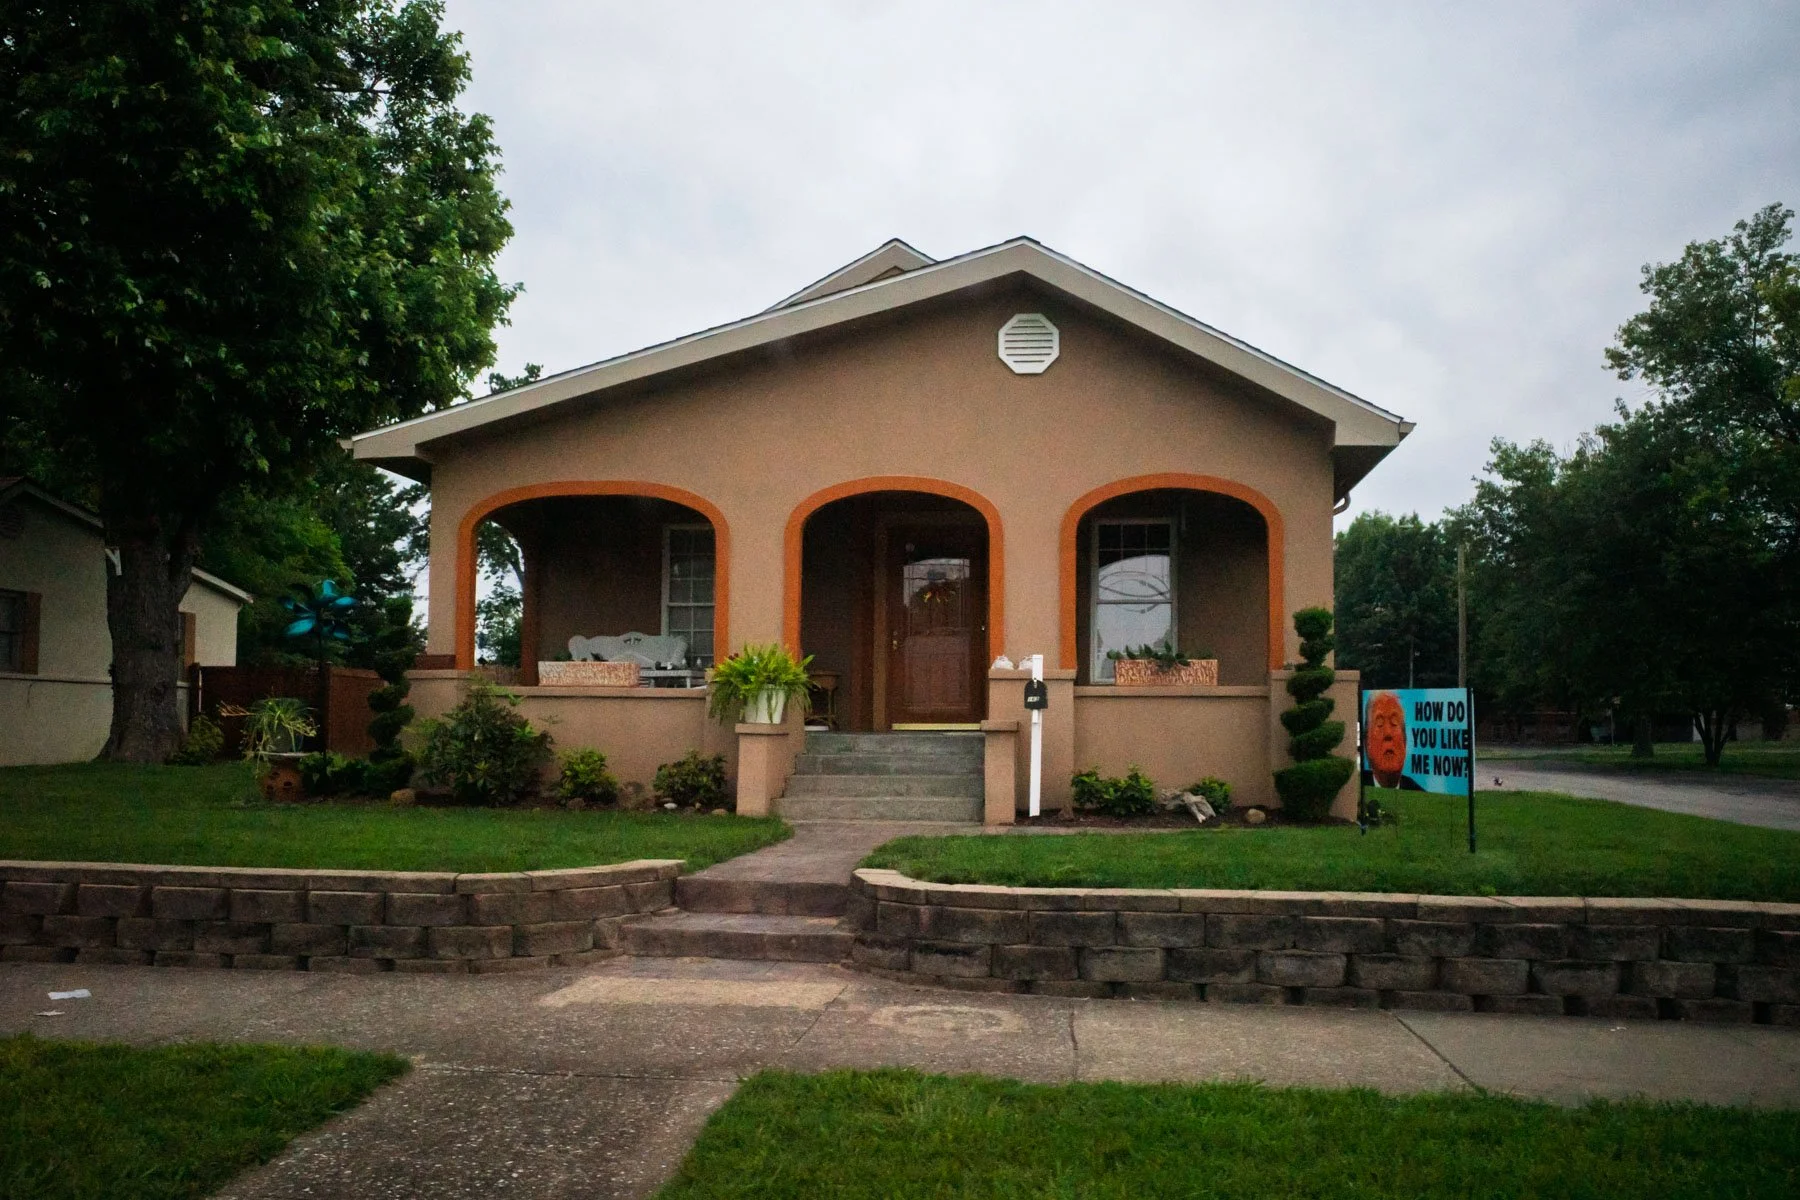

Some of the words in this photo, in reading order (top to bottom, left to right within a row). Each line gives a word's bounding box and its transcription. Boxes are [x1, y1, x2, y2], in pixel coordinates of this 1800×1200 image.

[1415, 701, 1443, 722] HOW
[1447, 701, 1465, 722] DO
[1411, 728, 1436, 749] YOU
[1441, 728, 1469, 750] LIKE
[1411, 755, 1430, 775] ME
